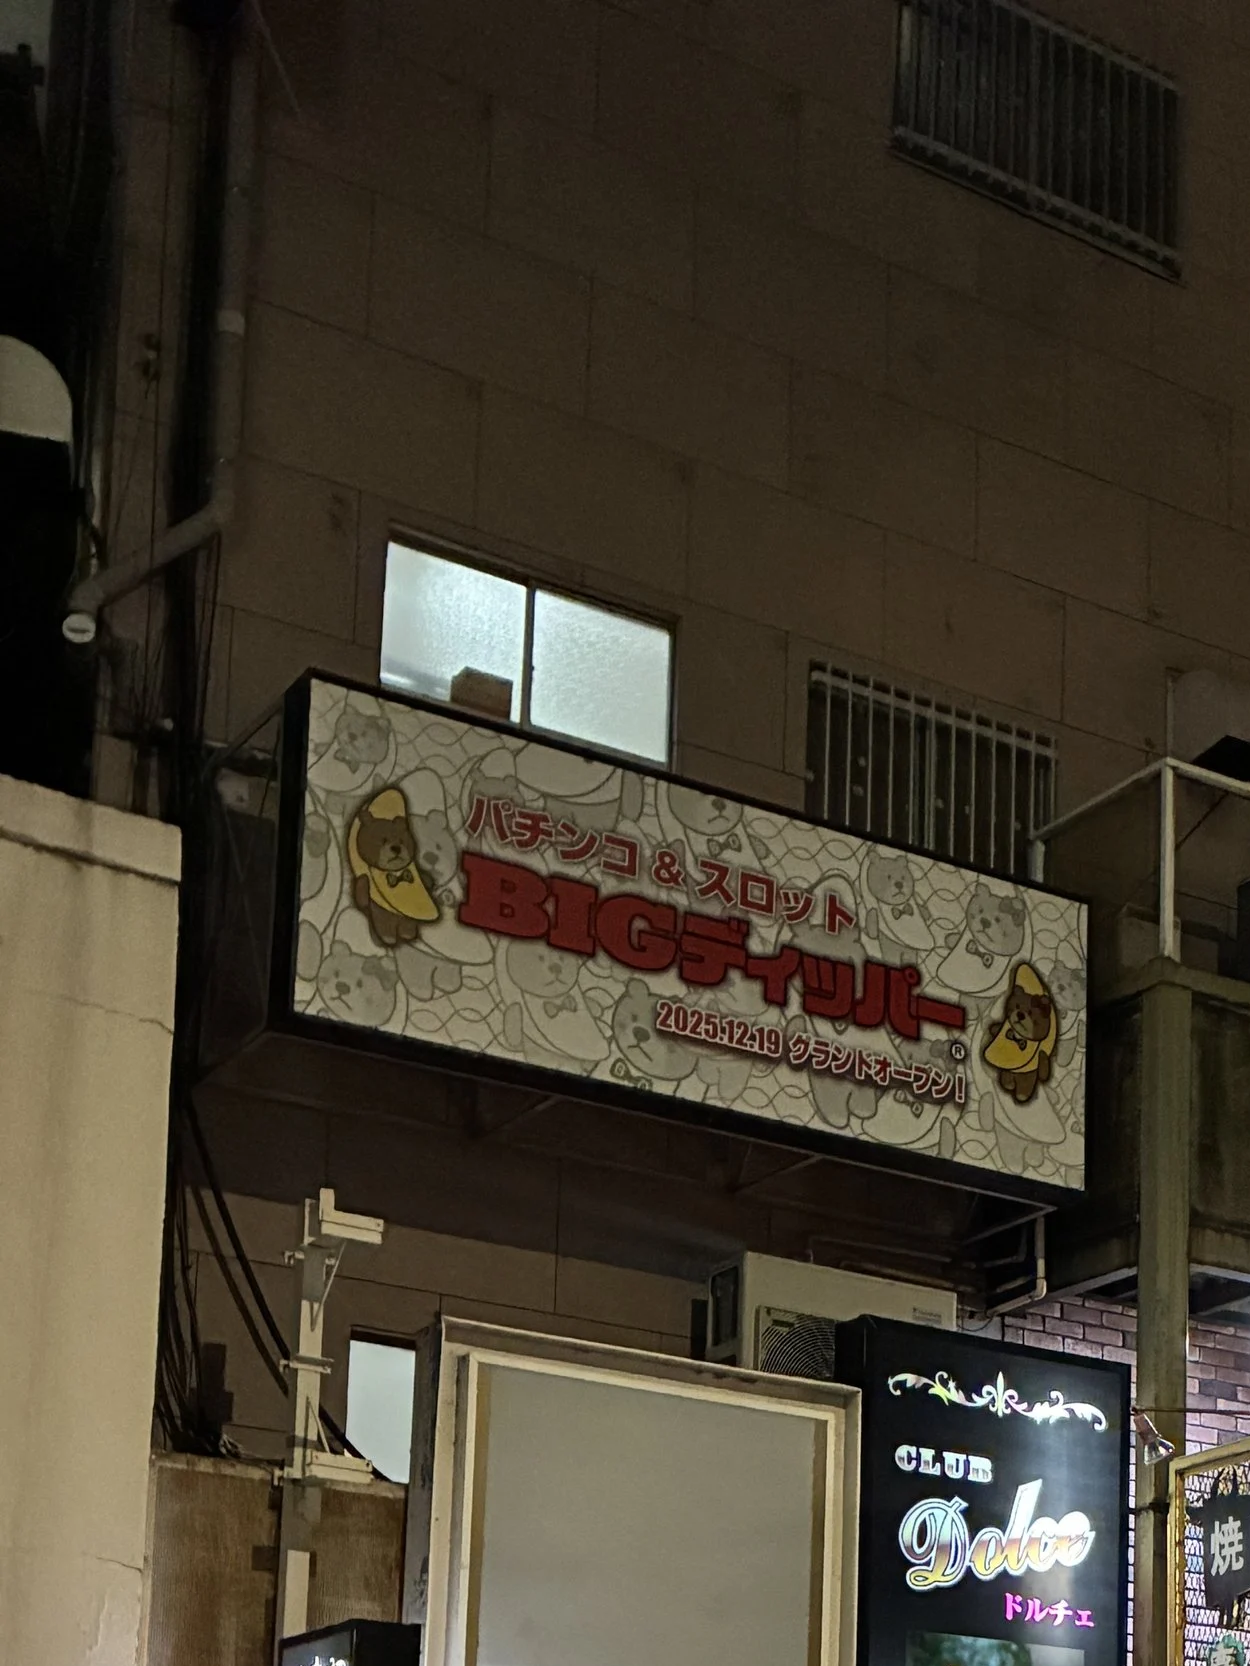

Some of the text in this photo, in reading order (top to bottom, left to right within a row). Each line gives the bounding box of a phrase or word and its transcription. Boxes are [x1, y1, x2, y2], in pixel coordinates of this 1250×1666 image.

[456, 851, 966, 1042] BIGディッパー
[656, 1001, 783, 1058] 2025.12.19
[894, 1443, 994, 1485] CLUB
[898, 1478, 1097, 1592] Dolce
[1002, 1592, 1097, 1630] ドルチェ
